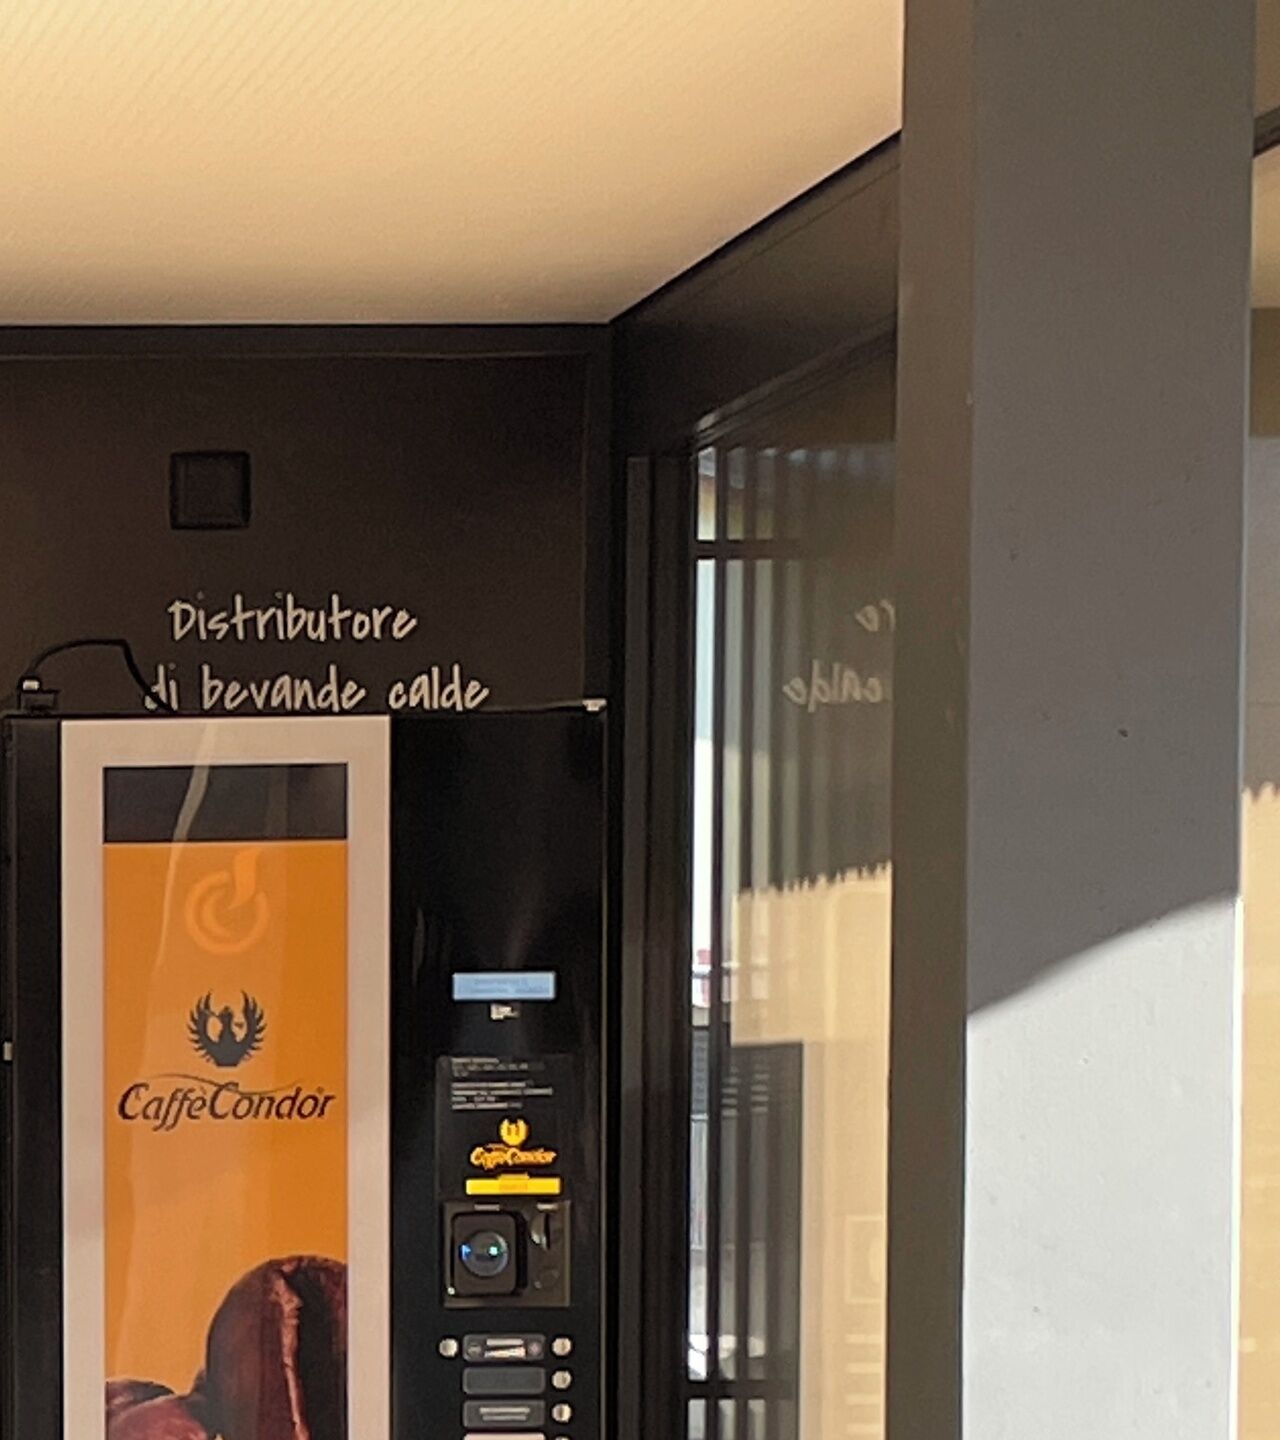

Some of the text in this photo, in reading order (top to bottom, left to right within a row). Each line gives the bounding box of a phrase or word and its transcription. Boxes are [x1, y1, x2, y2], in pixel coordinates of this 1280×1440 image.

[167, 592, 417, 642] Distributore
[202, 664, 366, 713] bevande
[388, 664, 490, 712] calde
